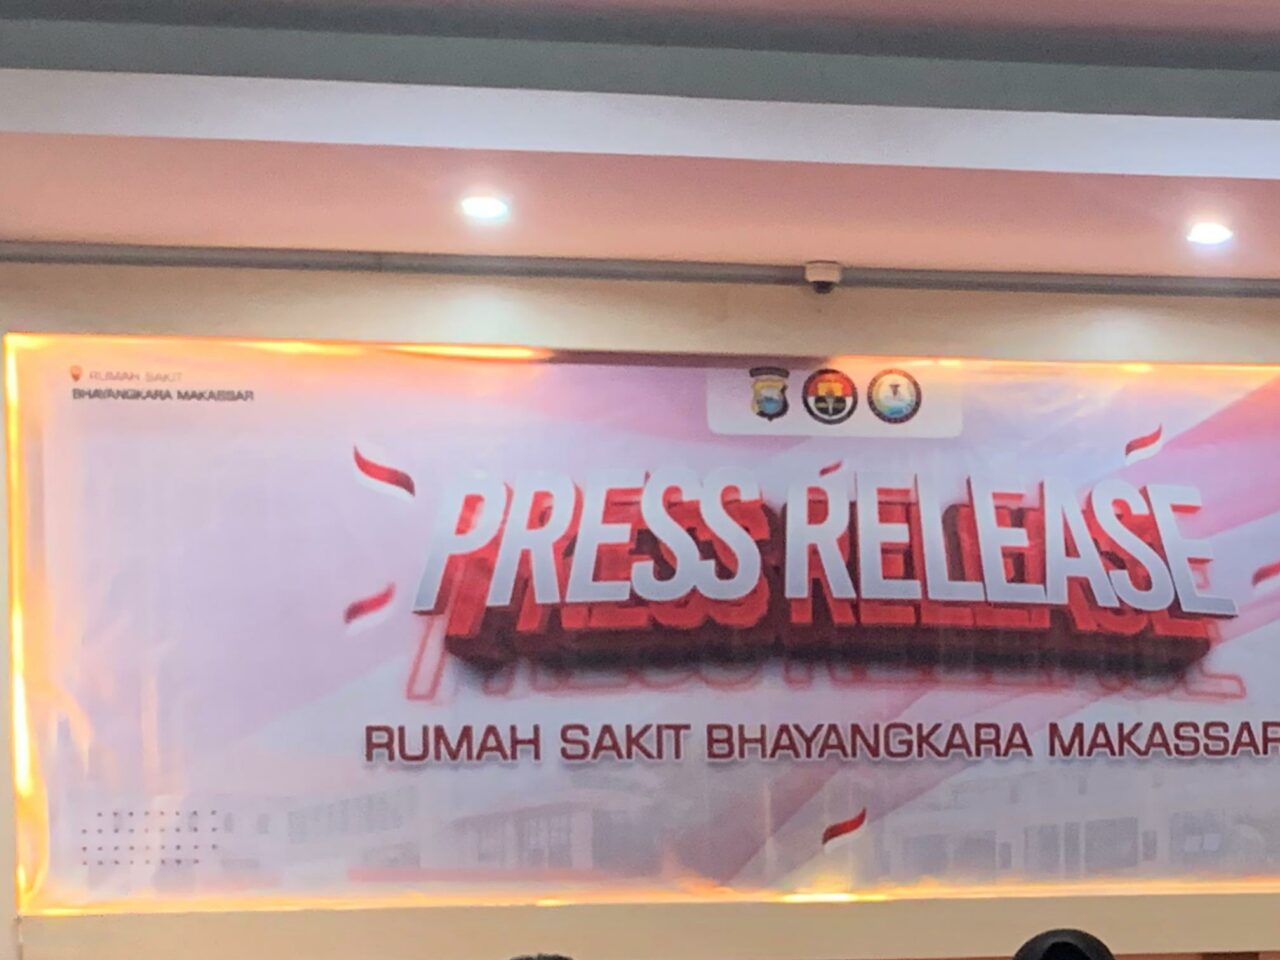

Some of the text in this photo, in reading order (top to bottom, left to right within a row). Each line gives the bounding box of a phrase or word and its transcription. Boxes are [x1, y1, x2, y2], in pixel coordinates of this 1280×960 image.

[412, 466, 1239, 620] PRESS RELEASE
[364, 723, 542, 763] RUMAH
[559, 722, 692, 762] SAKIT
[705, 721, 1034, 761] BHAYANGKARA
